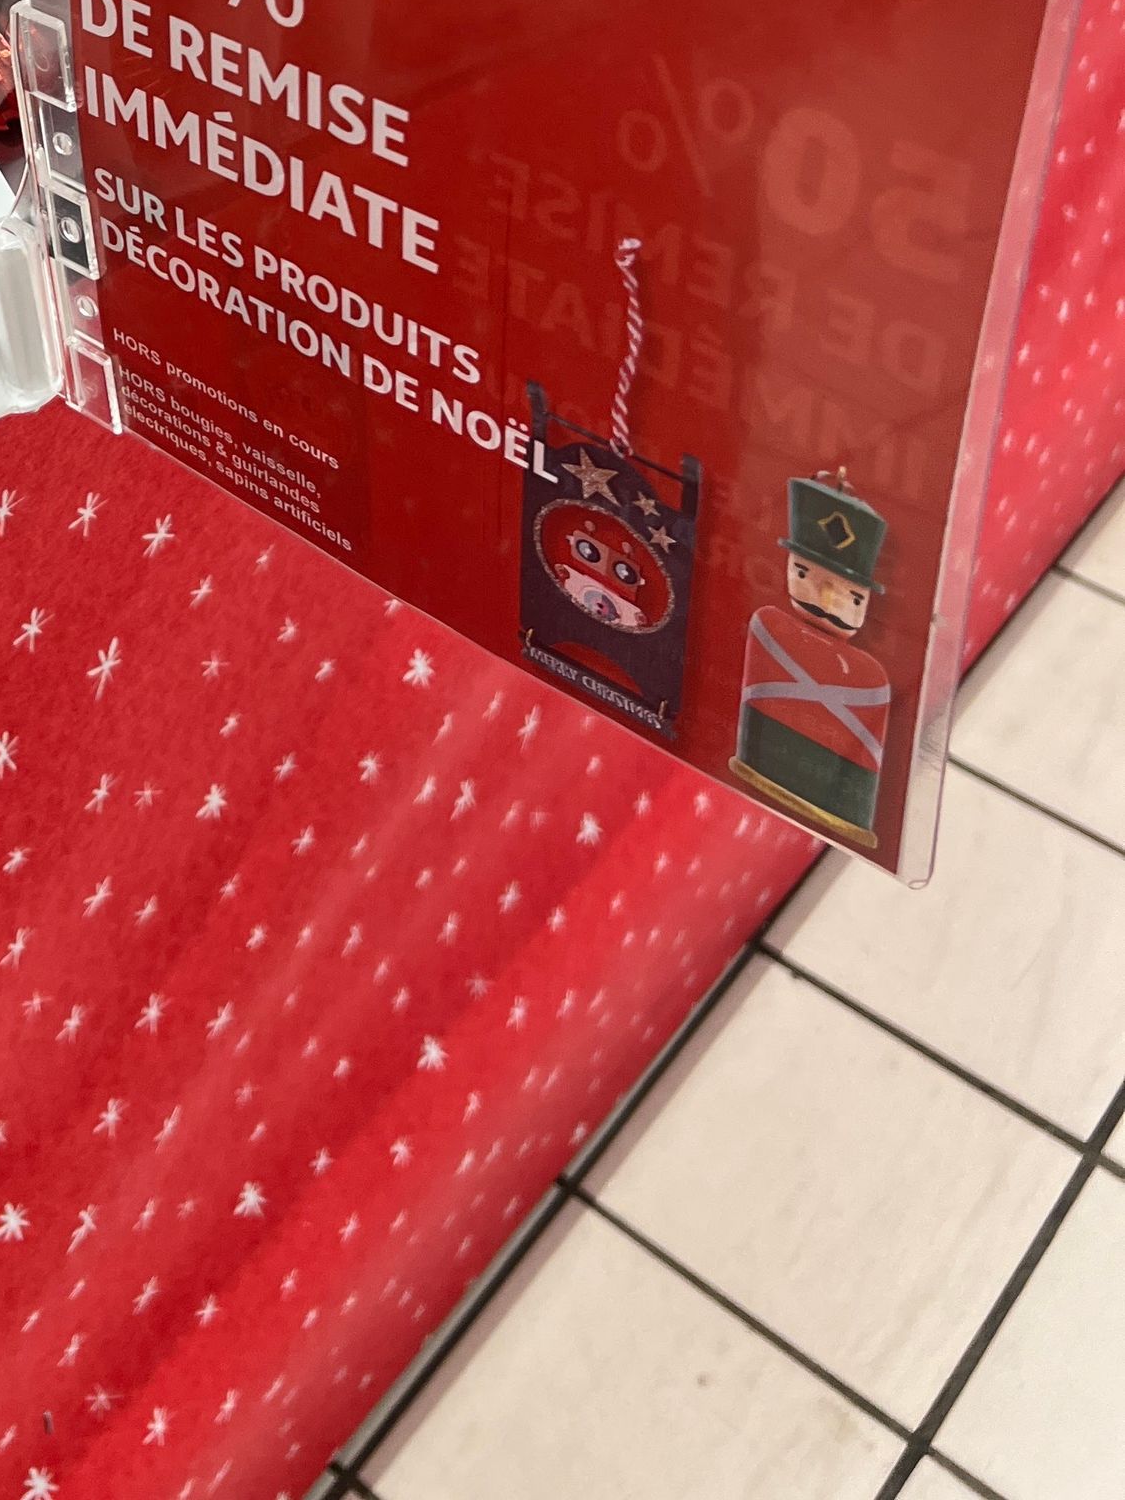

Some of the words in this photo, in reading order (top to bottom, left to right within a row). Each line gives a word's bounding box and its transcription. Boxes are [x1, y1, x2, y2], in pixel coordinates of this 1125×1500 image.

[169, 15, 410, 168] REMISE
[84, 65, 440, 275] IMMÉDIATE
[93, 167, 168, 232] SUR
[175, 206, 245, 268] LES
[254, 245, 481, 385] PRODUITS
[100, 216, 352, 379] DÉCORATION
[363, 354, 420, 414] DE
[432, 387, 559, 484] NOËL
[113, 328, 161, 366] HORS
[166, 362, 259, 424] promotions
[263, 417, 284, 439] en
[289, 432, 340, 470] cours
[118, 365, 166, 403] HORS
[170, 396, 239, 450] bougies,
[242, 442, 322, 499] vaisselle,
[121, 385, 211, 448] décorations
[216, 440, 228, 458] &
[232, 453, 320, 514] guirlandes
[124, 402, 212, 467] électriques,
[216, 461, 269, 501] sapins
[274, 498, 352, 552] artificiels
